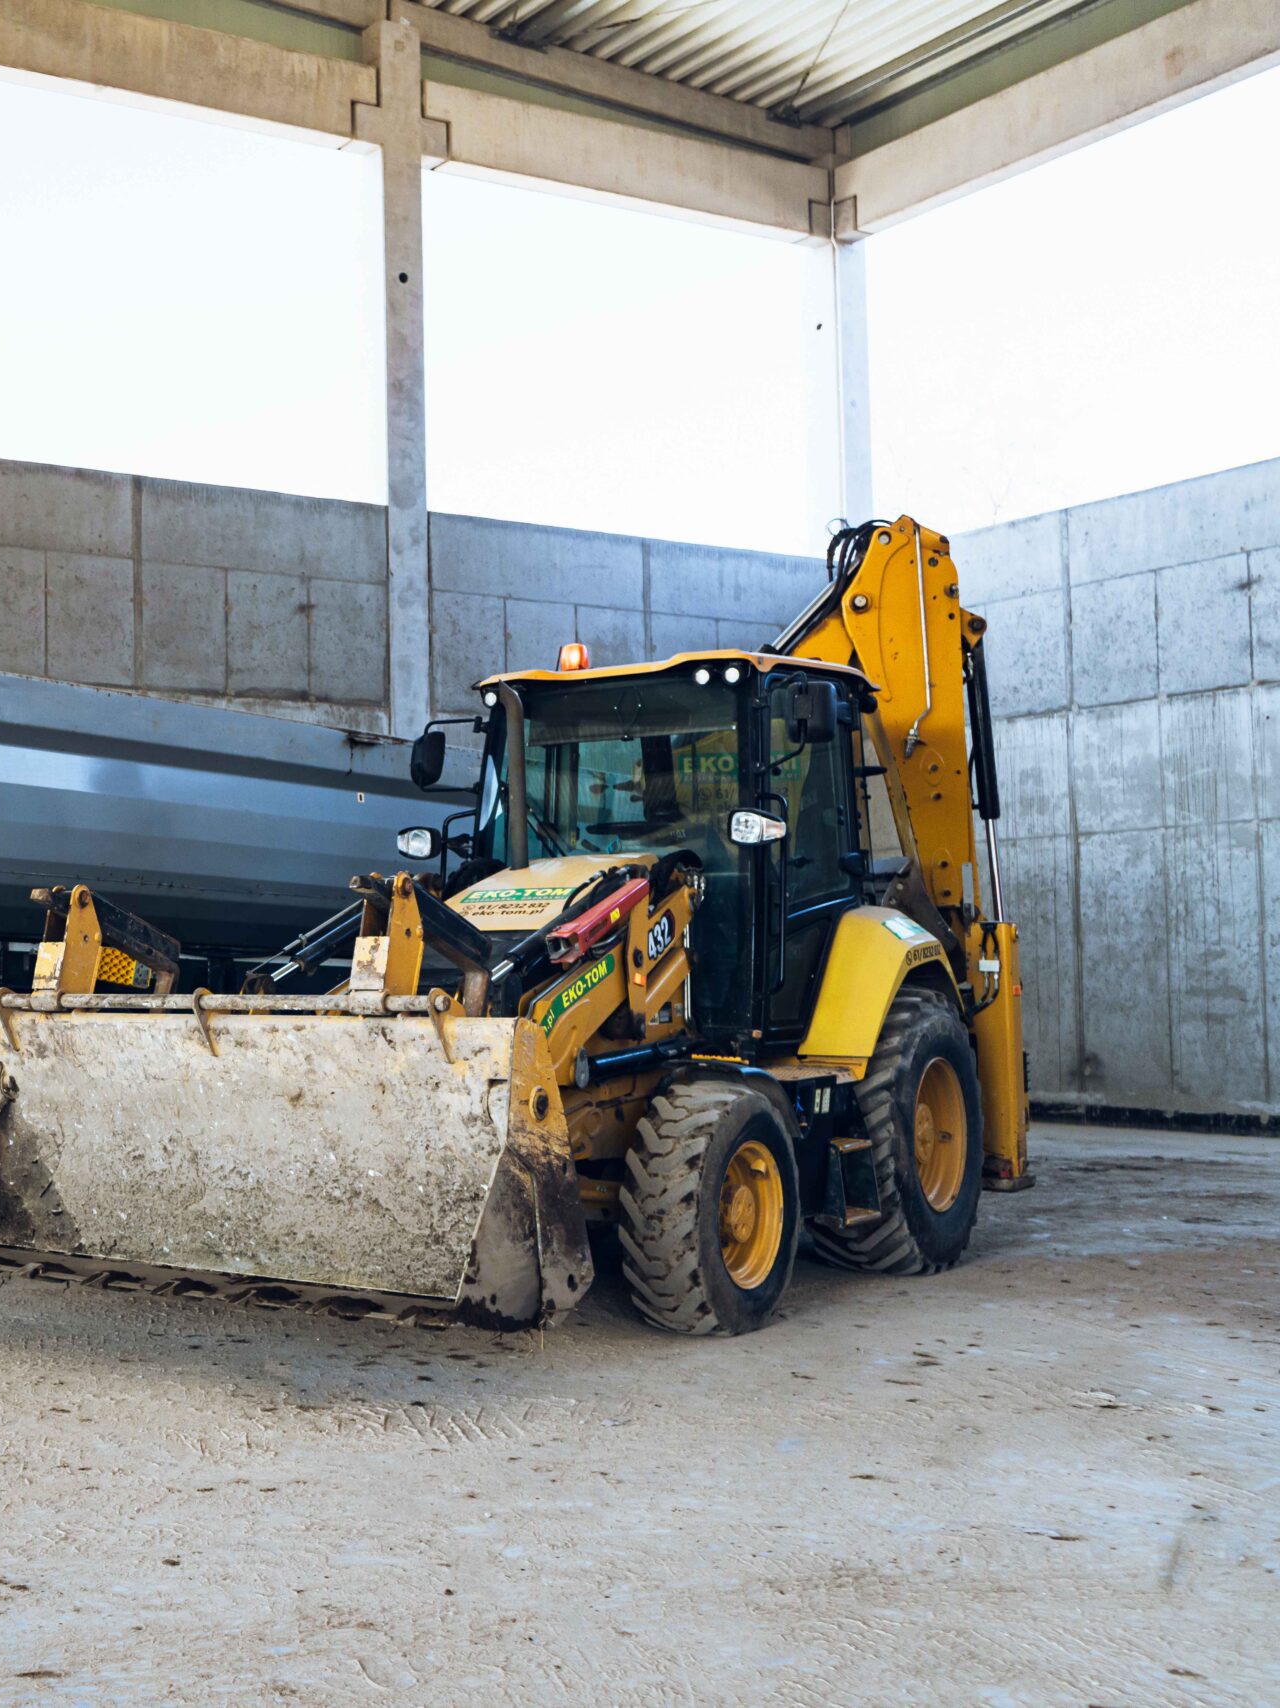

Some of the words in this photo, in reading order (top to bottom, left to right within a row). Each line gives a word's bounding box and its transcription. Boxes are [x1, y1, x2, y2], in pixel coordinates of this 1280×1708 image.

[469, 888, 572, 899] EKO-TOM
[648, 916, 671, 960] 432
[562, 960, 608, 1008] EKO-TOM
